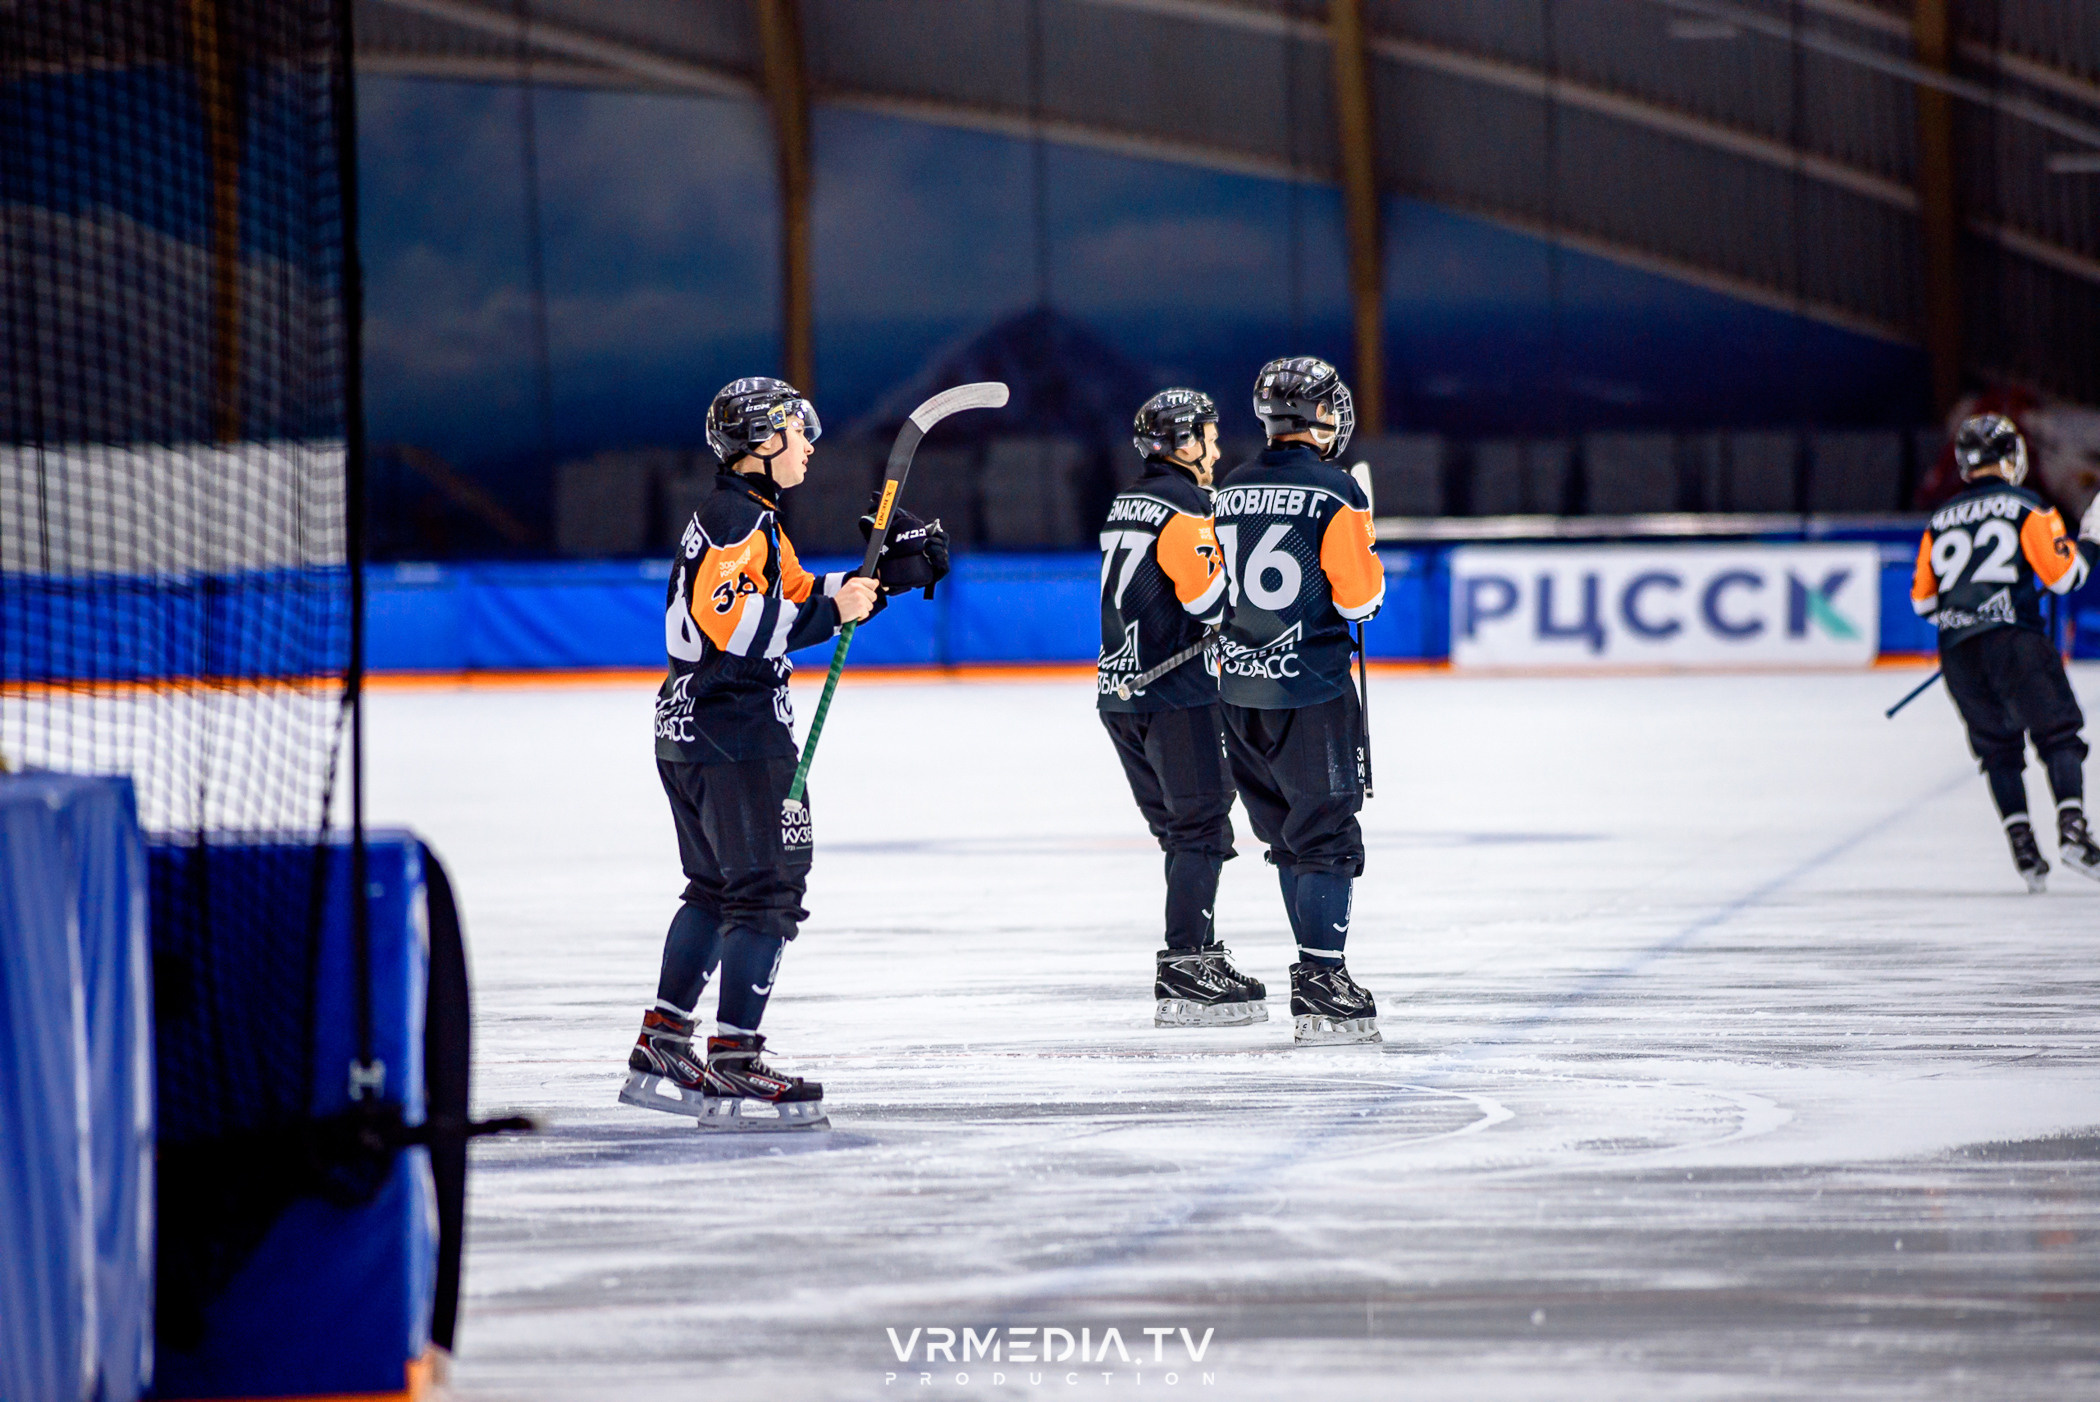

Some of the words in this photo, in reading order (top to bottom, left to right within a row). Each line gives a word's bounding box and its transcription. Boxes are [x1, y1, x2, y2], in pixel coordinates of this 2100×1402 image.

[895, 528, 927, 543] CCM
[1215, 489, 1307, 518] ЯКОВЛЕВ
[1099, 530, 1157, 612] 77
[1215, 524, 1302, 611] 16
[1930, 518, 2020, 594] 92
[1465, 567, 1862, 655] РЦССК
